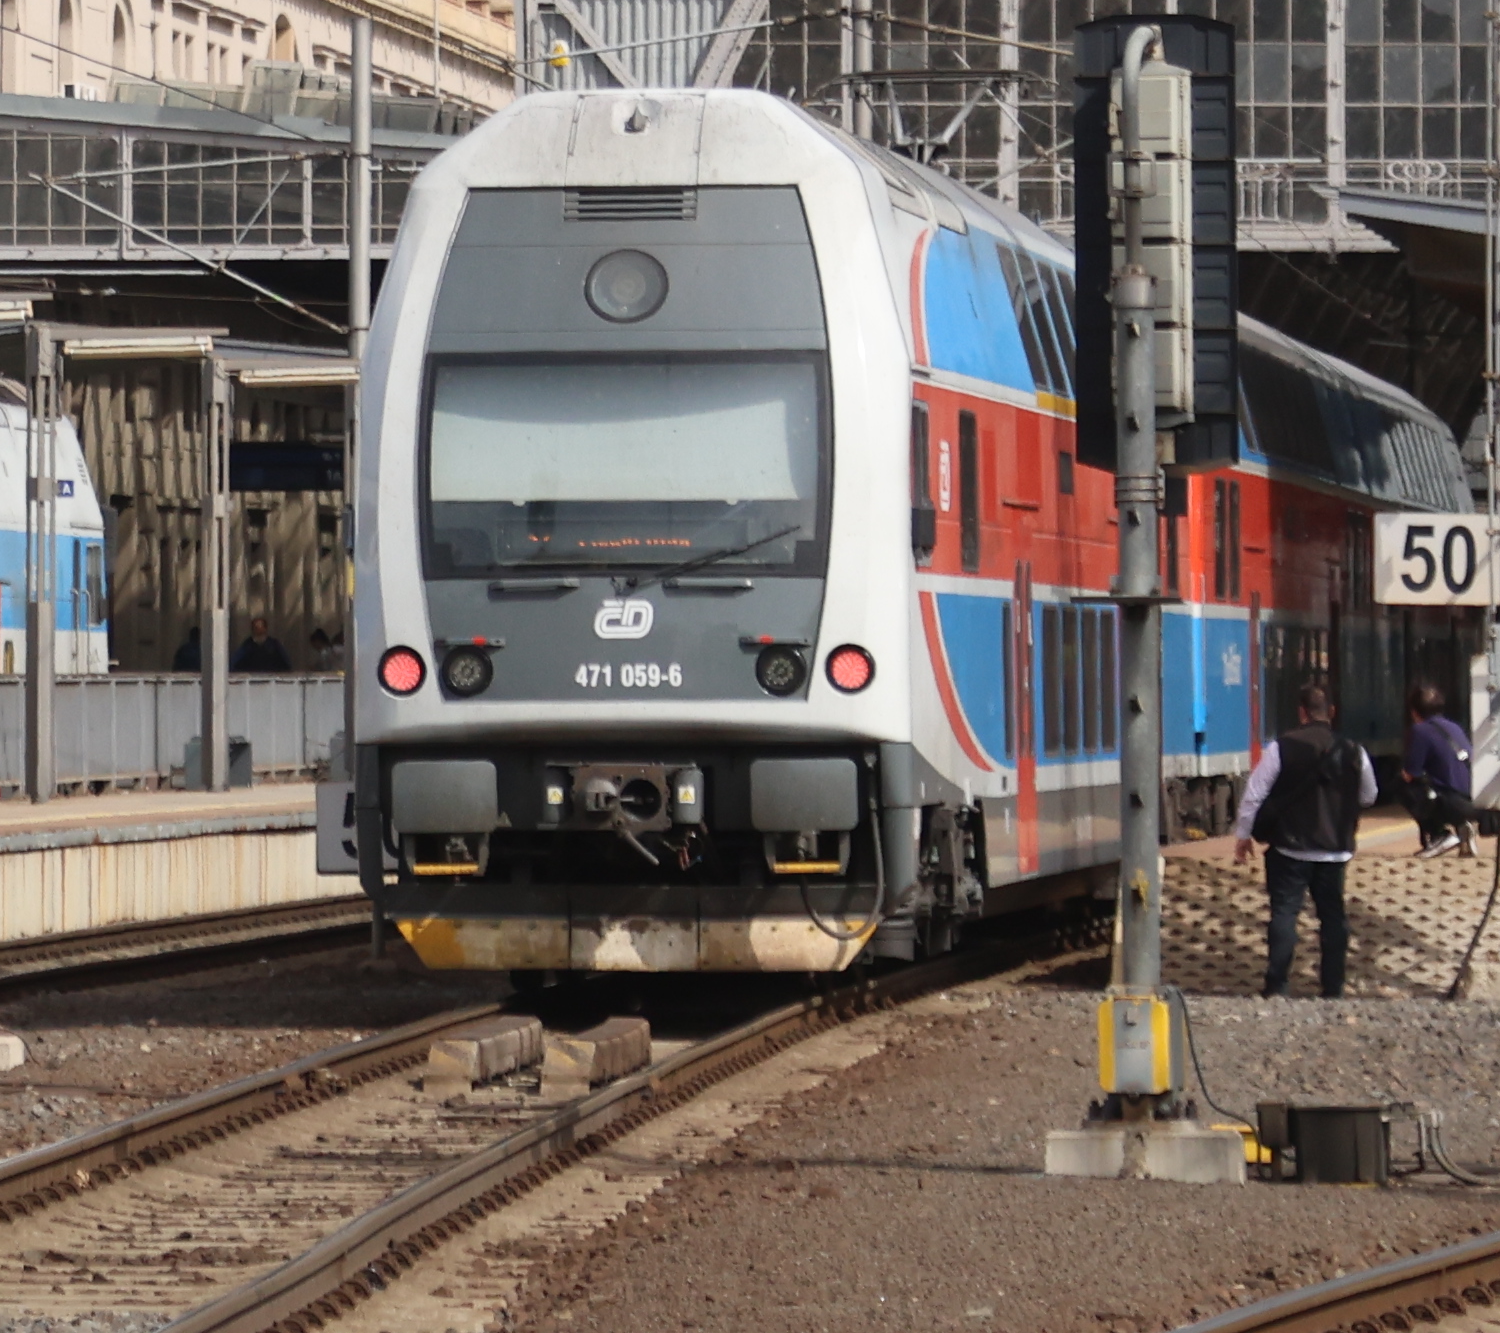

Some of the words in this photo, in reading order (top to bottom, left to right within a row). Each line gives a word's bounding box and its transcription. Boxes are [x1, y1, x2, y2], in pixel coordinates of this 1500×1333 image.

[62, 483, 72, 495] A
[1401, 525, 1477, 594] 50
[575, 663, 613, 687] 471
[620, 662, 683, 687] 059-6
